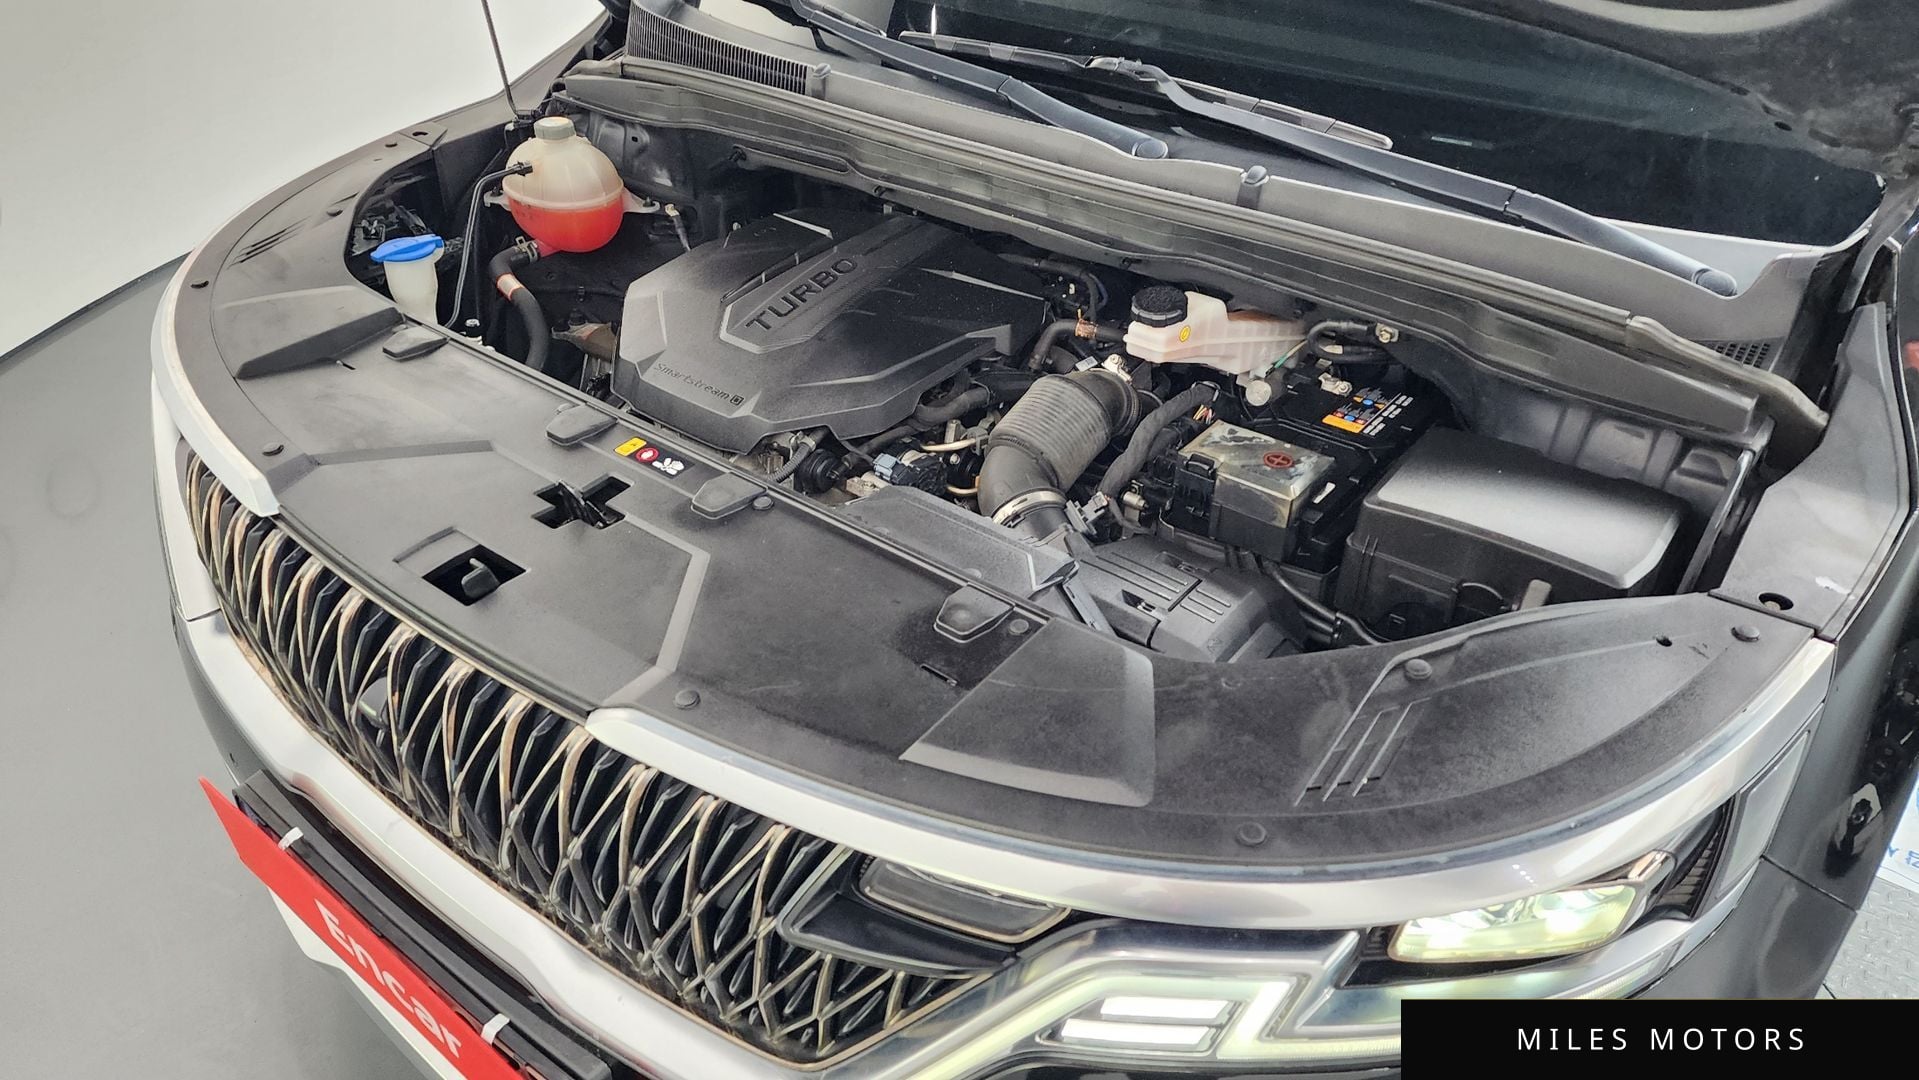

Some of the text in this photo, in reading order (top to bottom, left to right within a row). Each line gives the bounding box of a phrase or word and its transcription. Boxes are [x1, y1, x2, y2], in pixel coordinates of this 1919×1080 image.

[745, 259, 858, 331] TURBO
[654, 363, 730, 400] Smartstream
[314, 898, 462, 1058] Encar
